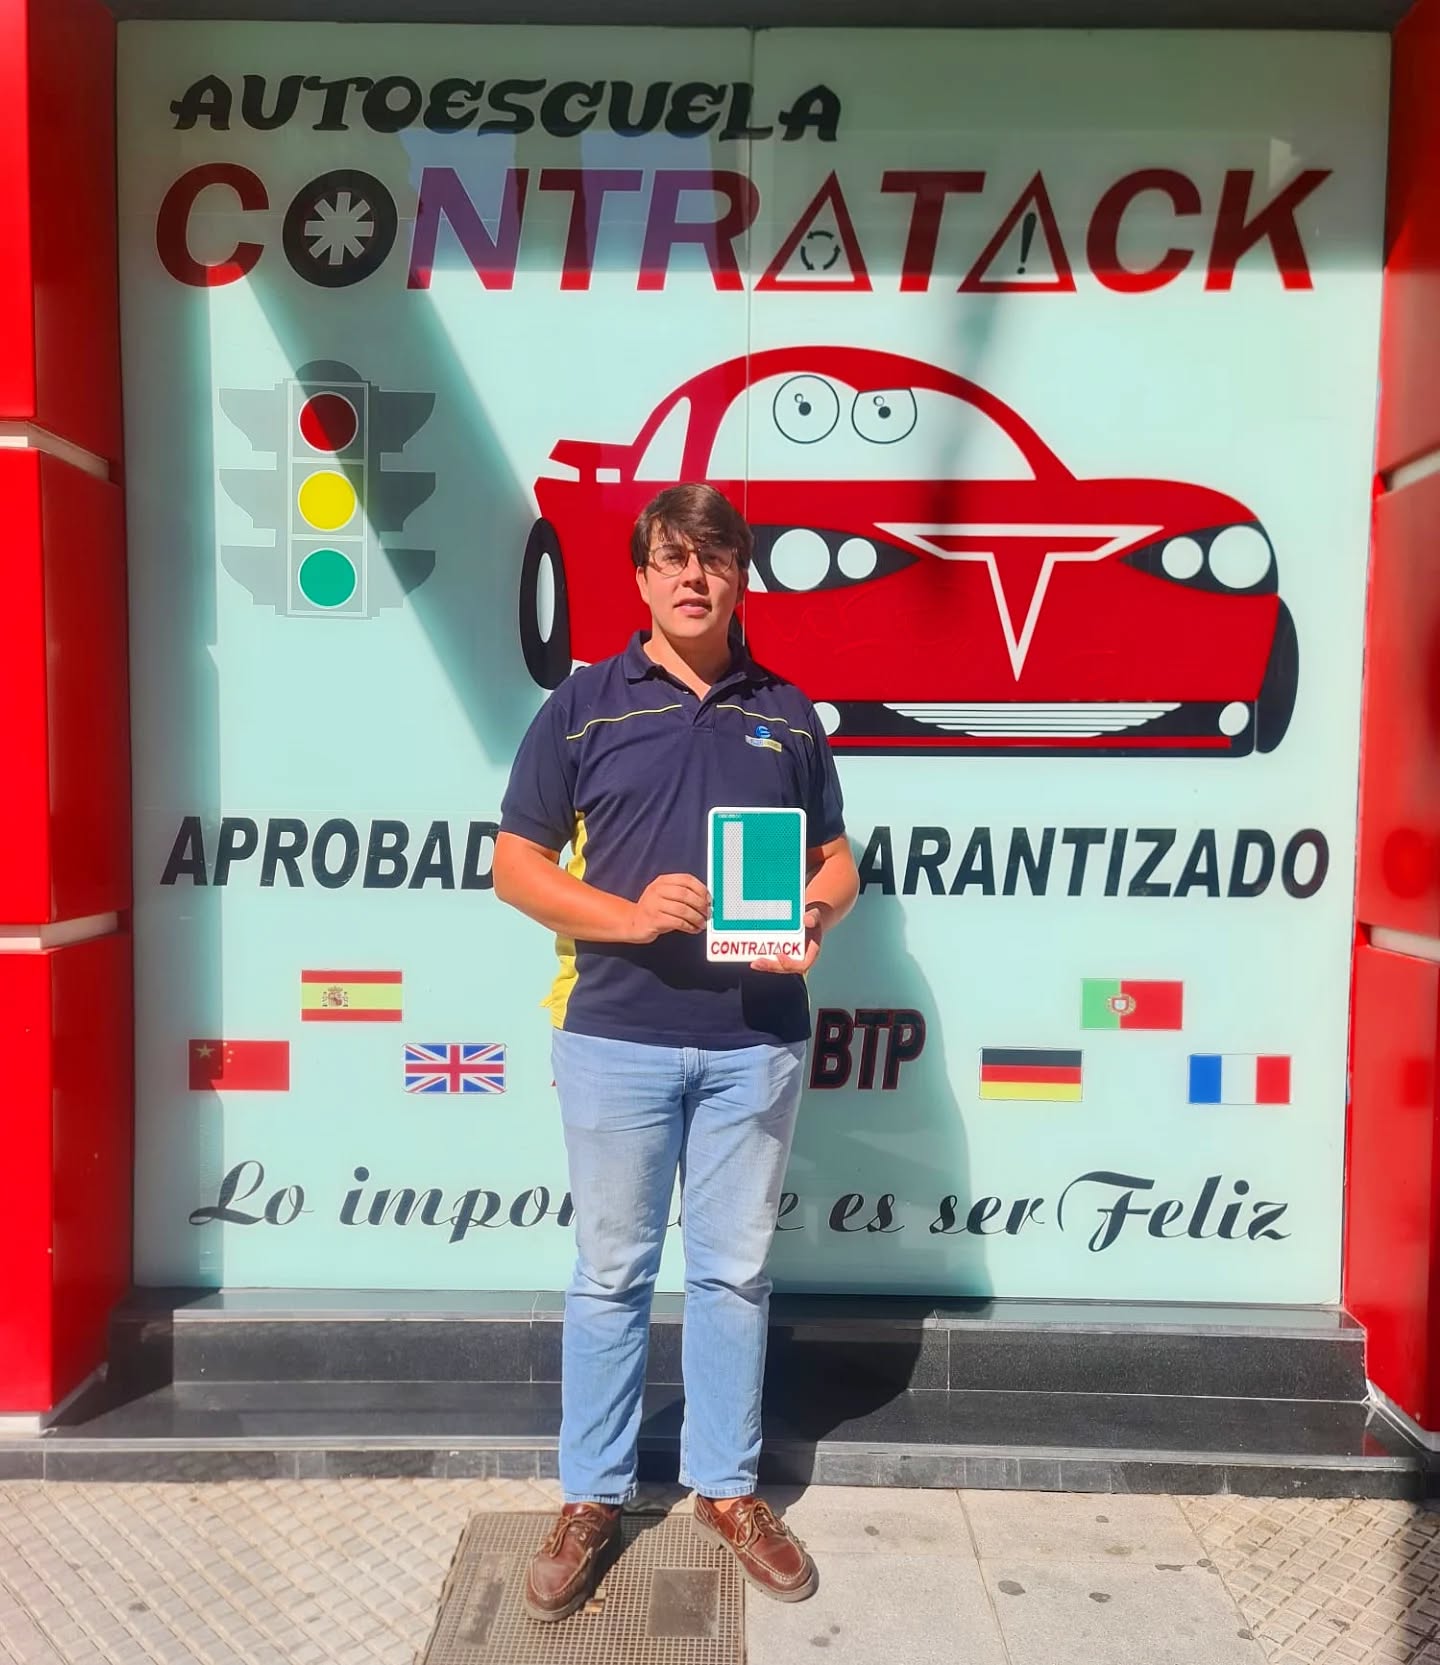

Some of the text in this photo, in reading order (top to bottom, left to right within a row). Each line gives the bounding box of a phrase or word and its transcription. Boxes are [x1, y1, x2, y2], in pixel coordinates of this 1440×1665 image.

[170, 74, 842, 142] AUTOESCUELA
[156, 162, 1334, 294] CONTRATACK
[160, 816, 1330, 899] APROBAD ARANTIZADO
[722, 821, 792, 921] L
[710, 940, 801, 956] CONTRATACK
[808, 1007, 926, 1089] BTP
[188, 1160, 312, 1228] Lo
[828, 1193, 905, 1234] es
[929, 1195, 1046, 1235] ser
[1056, 1170, 1293, 1253] Feliz
